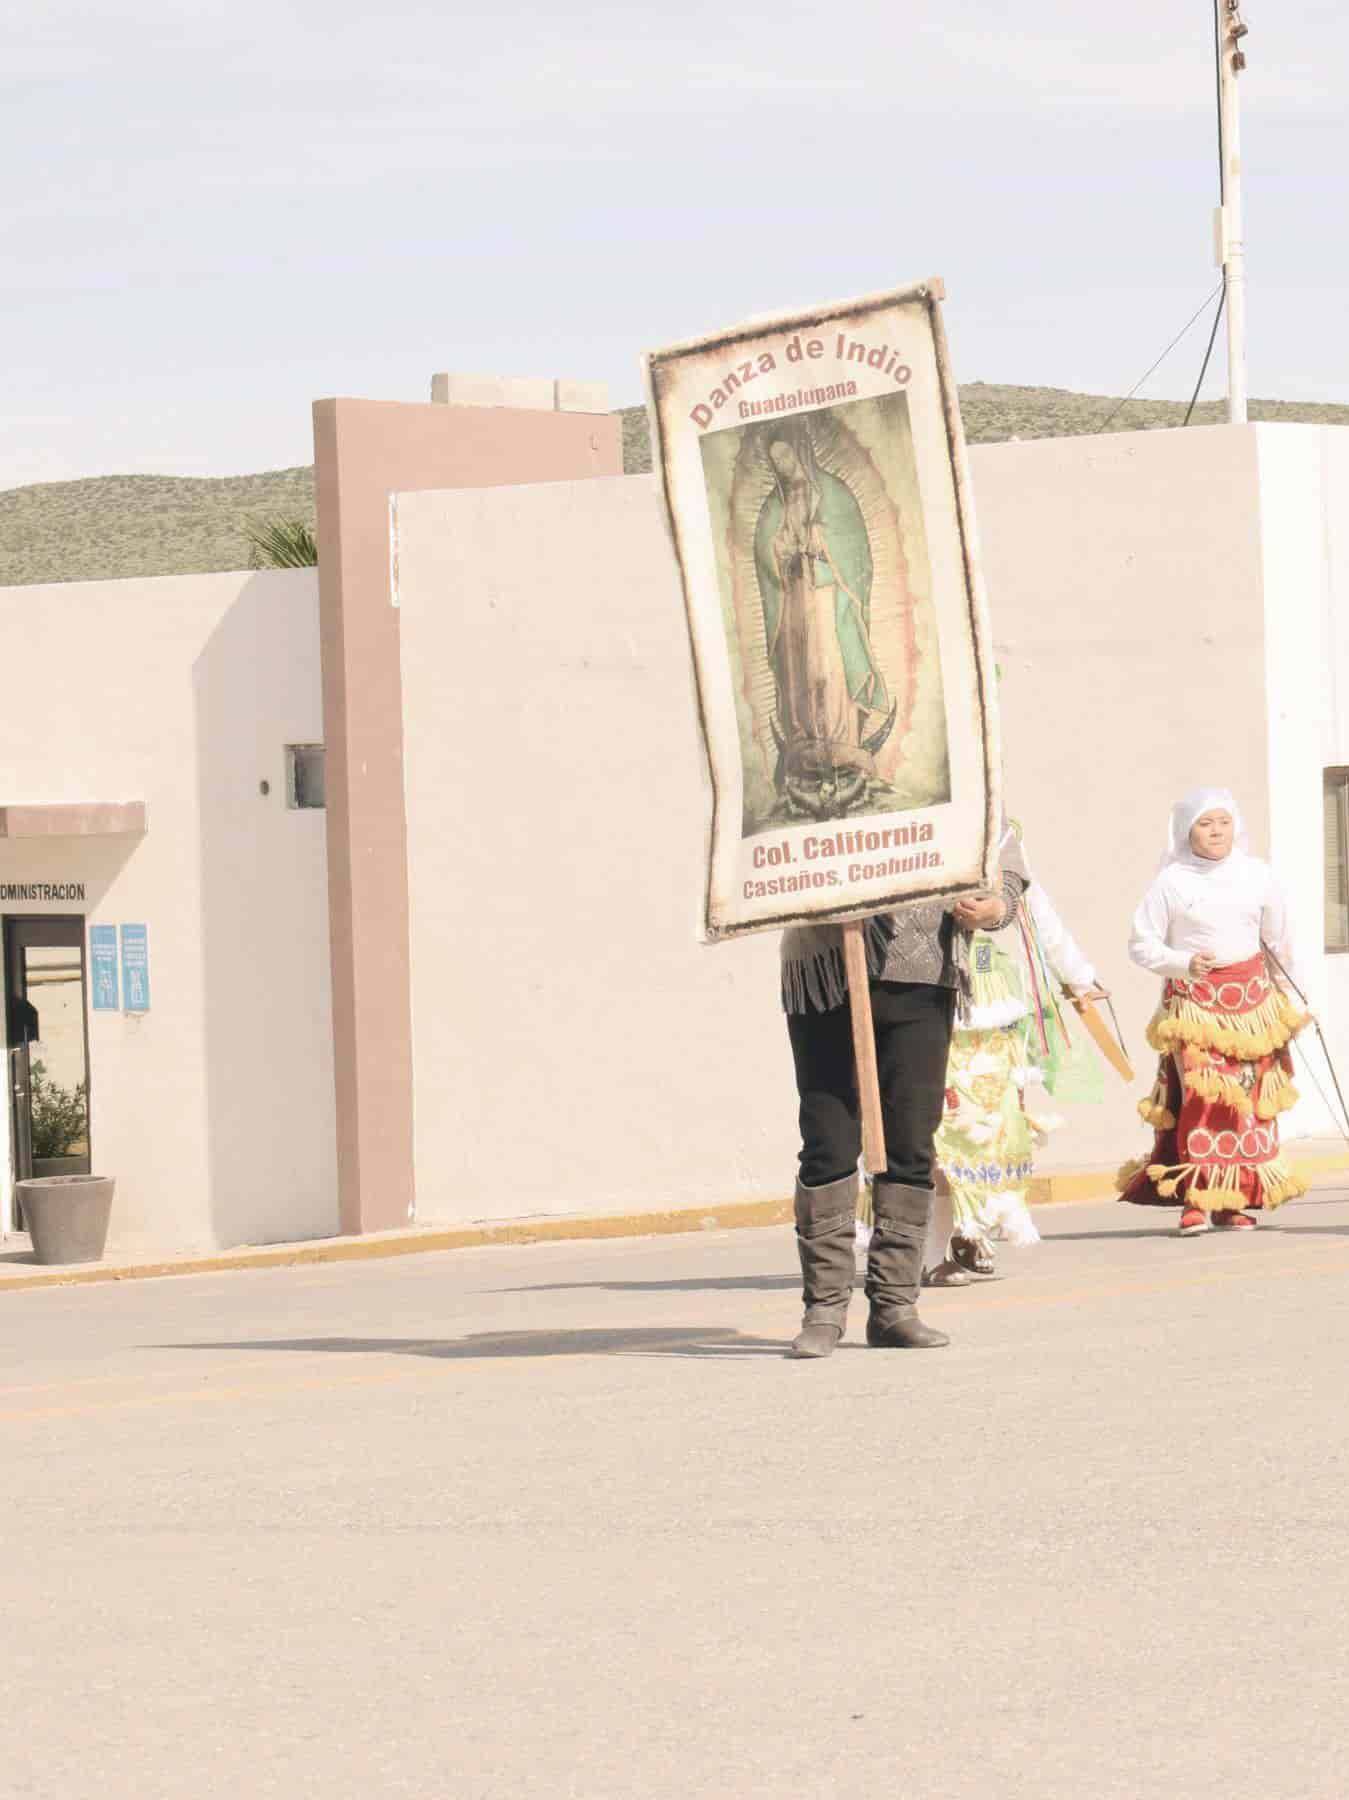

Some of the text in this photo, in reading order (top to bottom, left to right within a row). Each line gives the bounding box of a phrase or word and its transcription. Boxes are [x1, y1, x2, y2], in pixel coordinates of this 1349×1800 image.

[690, 334, 912, 428] Danza de Indio
[738, 380, 857, 418] Guadalupana
[753, 822, 933, 869] Col. California
[743, 852, 945, 900] Castaños, Coahuila.
